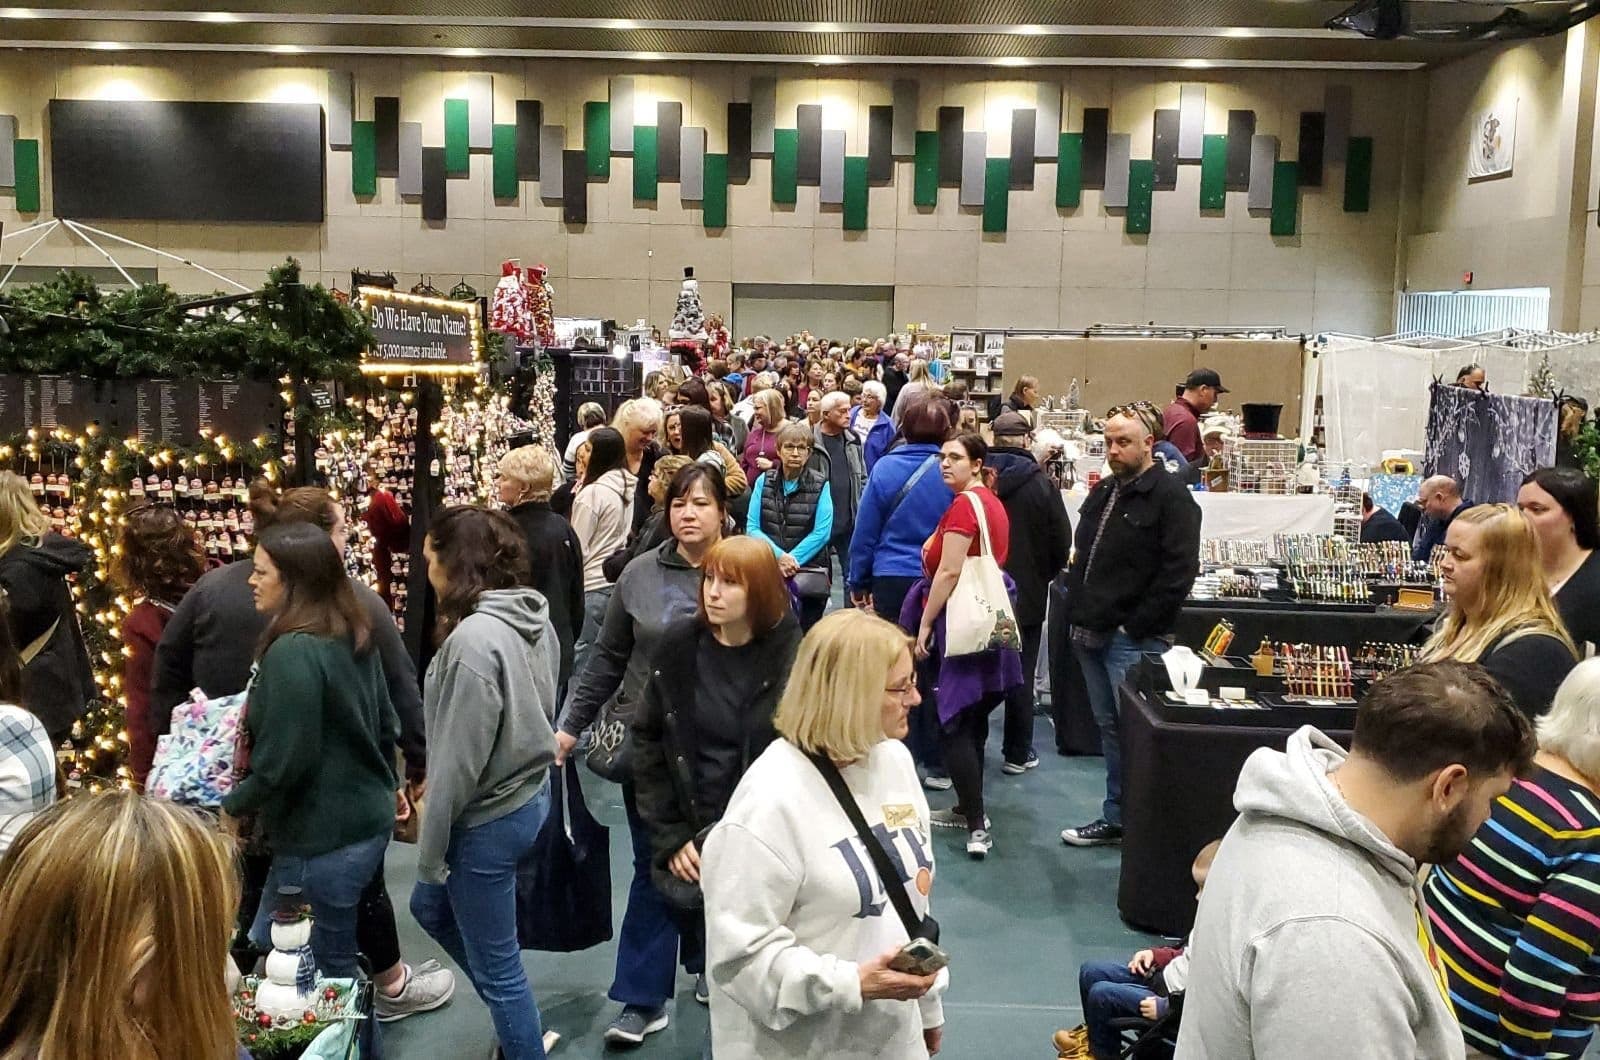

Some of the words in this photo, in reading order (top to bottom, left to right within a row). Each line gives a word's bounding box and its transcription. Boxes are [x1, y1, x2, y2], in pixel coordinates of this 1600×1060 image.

[371, 305, 384, 328] Do
[385, 307, 399, 330] We
[400, 309, 420, 332] Have
[421, 312, 441, 334] Your
[383, 343, 400, 360] 5,000
[401, 345, 420, 358] names
[421, 342, 448, 359] available.
